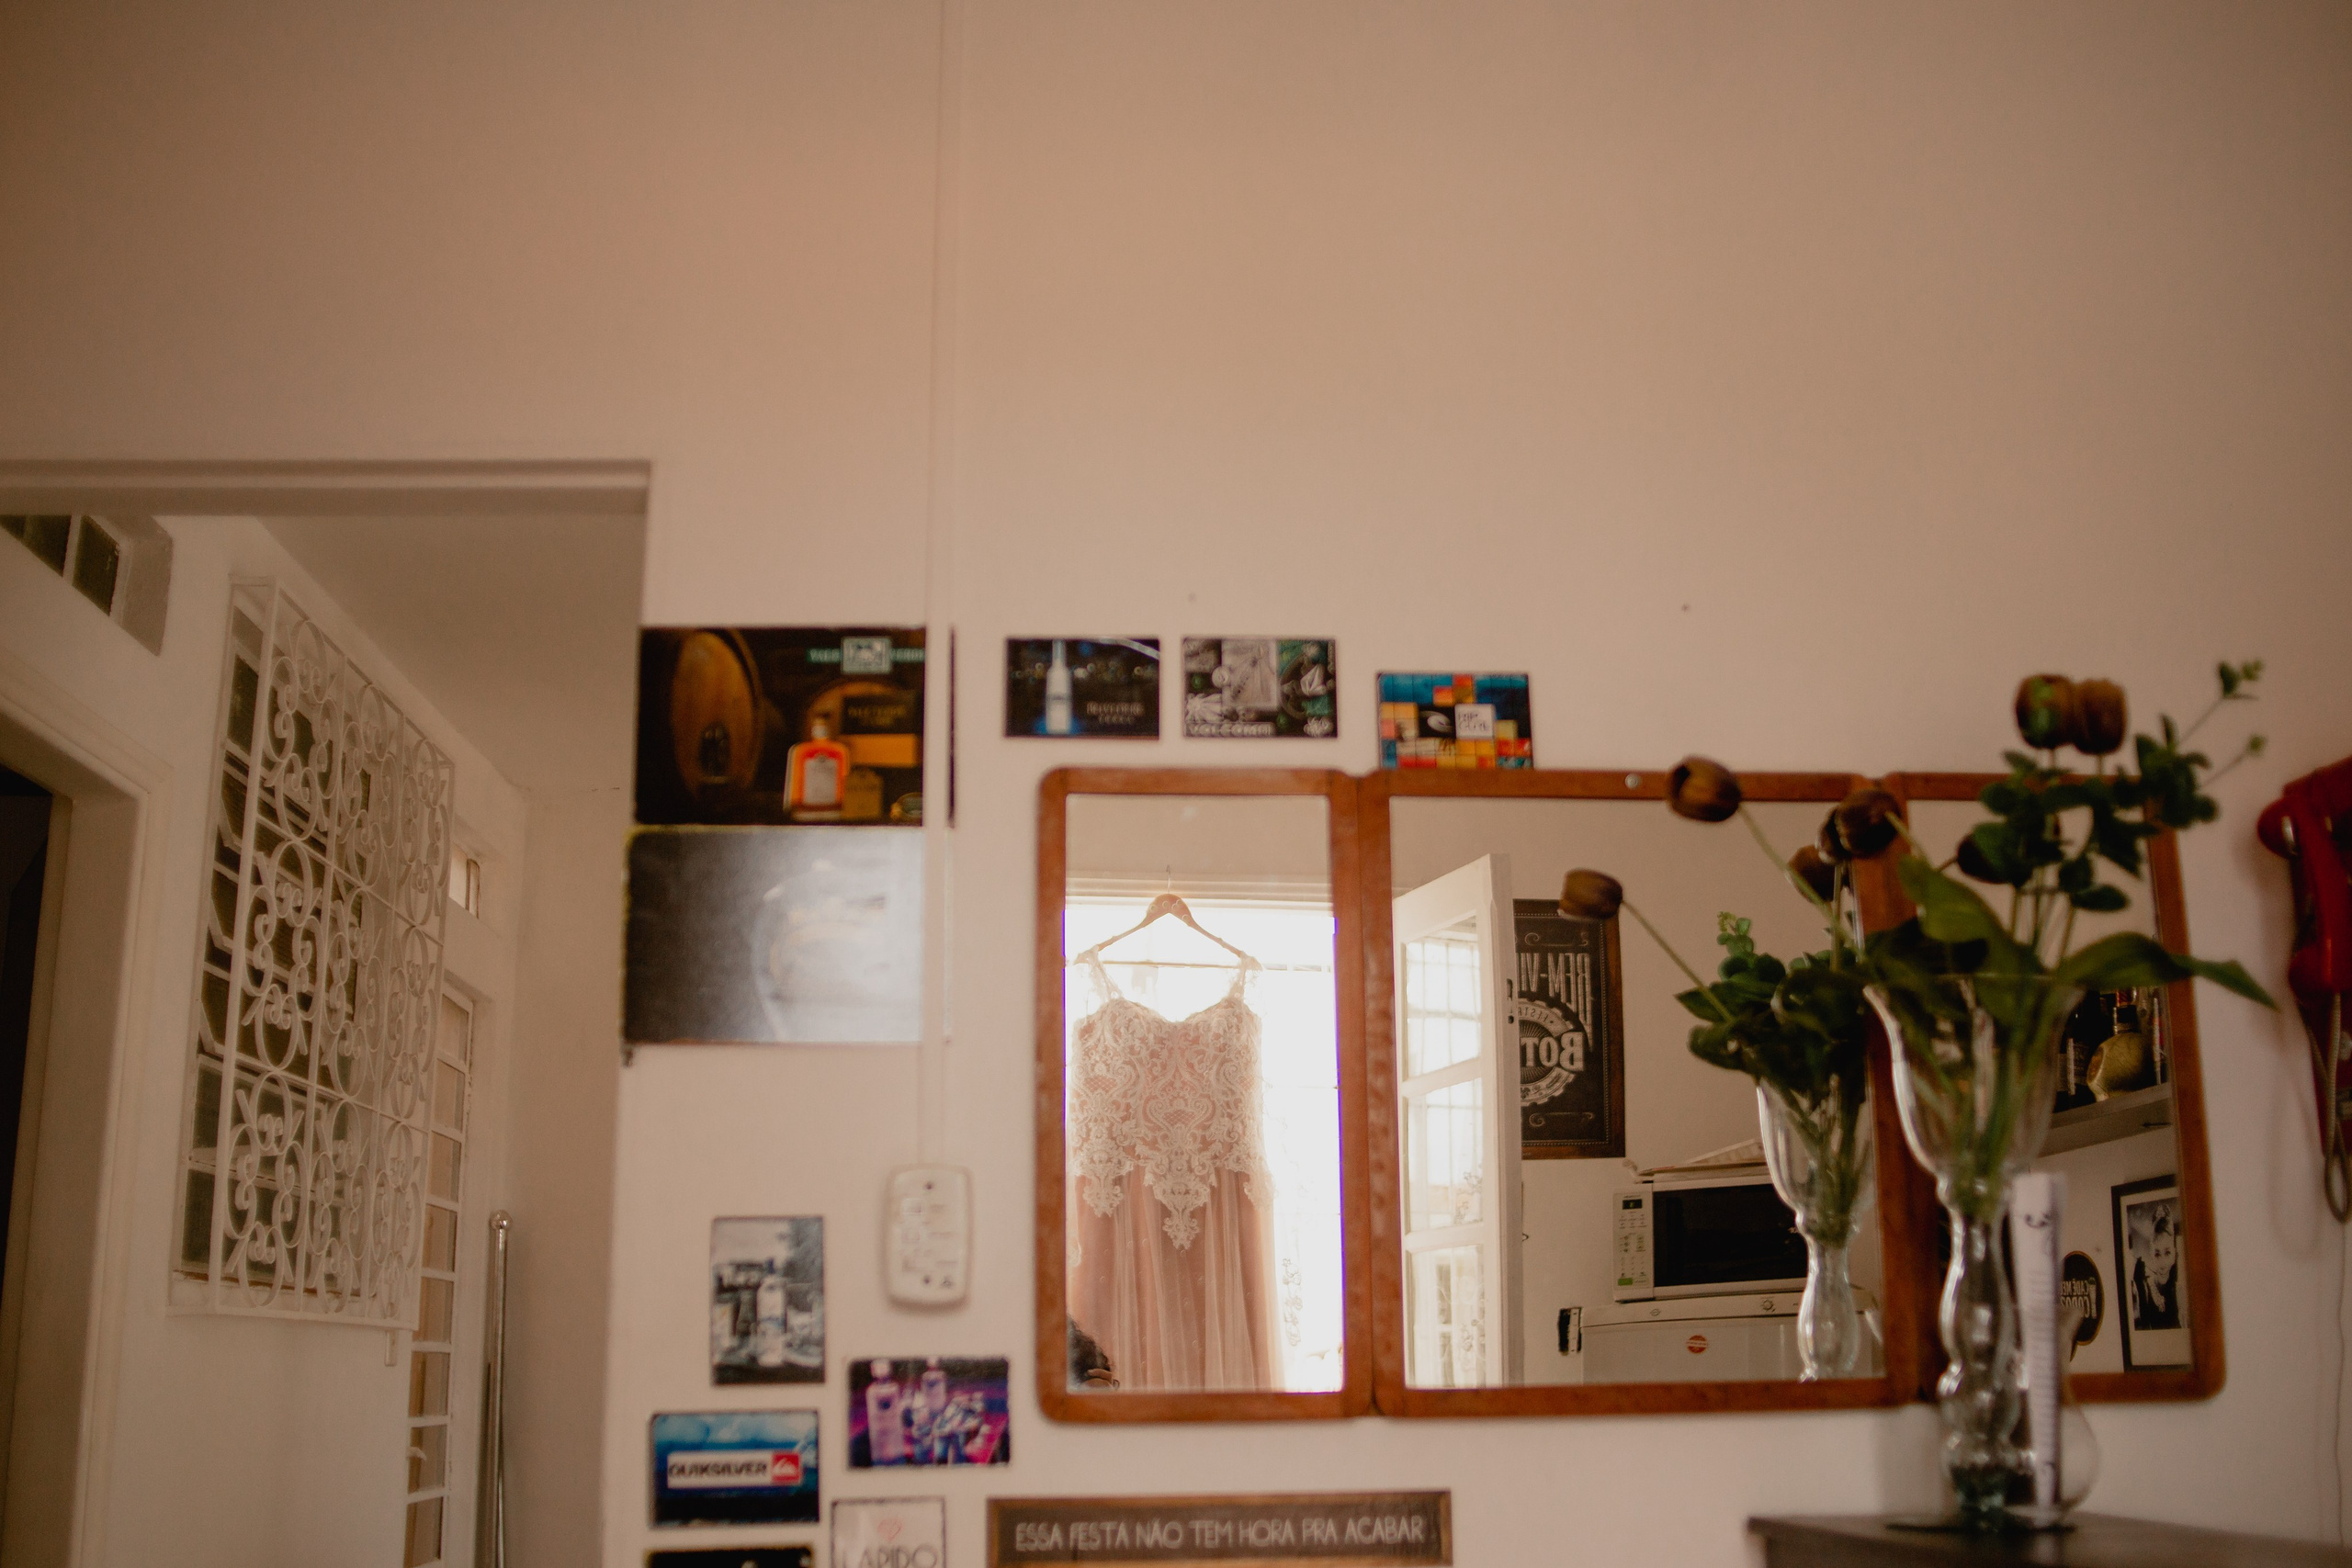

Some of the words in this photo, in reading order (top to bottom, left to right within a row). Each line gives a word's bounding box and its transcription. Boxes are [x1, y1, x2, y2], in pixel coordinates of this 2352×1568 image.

[1015, 1522, 1063, 1551] ESSA
[1069, 1520, 1131, 1551] FESTA
[1136, 1516, 1183, 1549] NÃO
[1191, 1519, 1233, 1549] TEM
[1238, 1518, 1294, 1547] HORA
[1302, 1517, 1338, 1546] PRA
[1344, 1514, 1425, 1544] ACABAR
